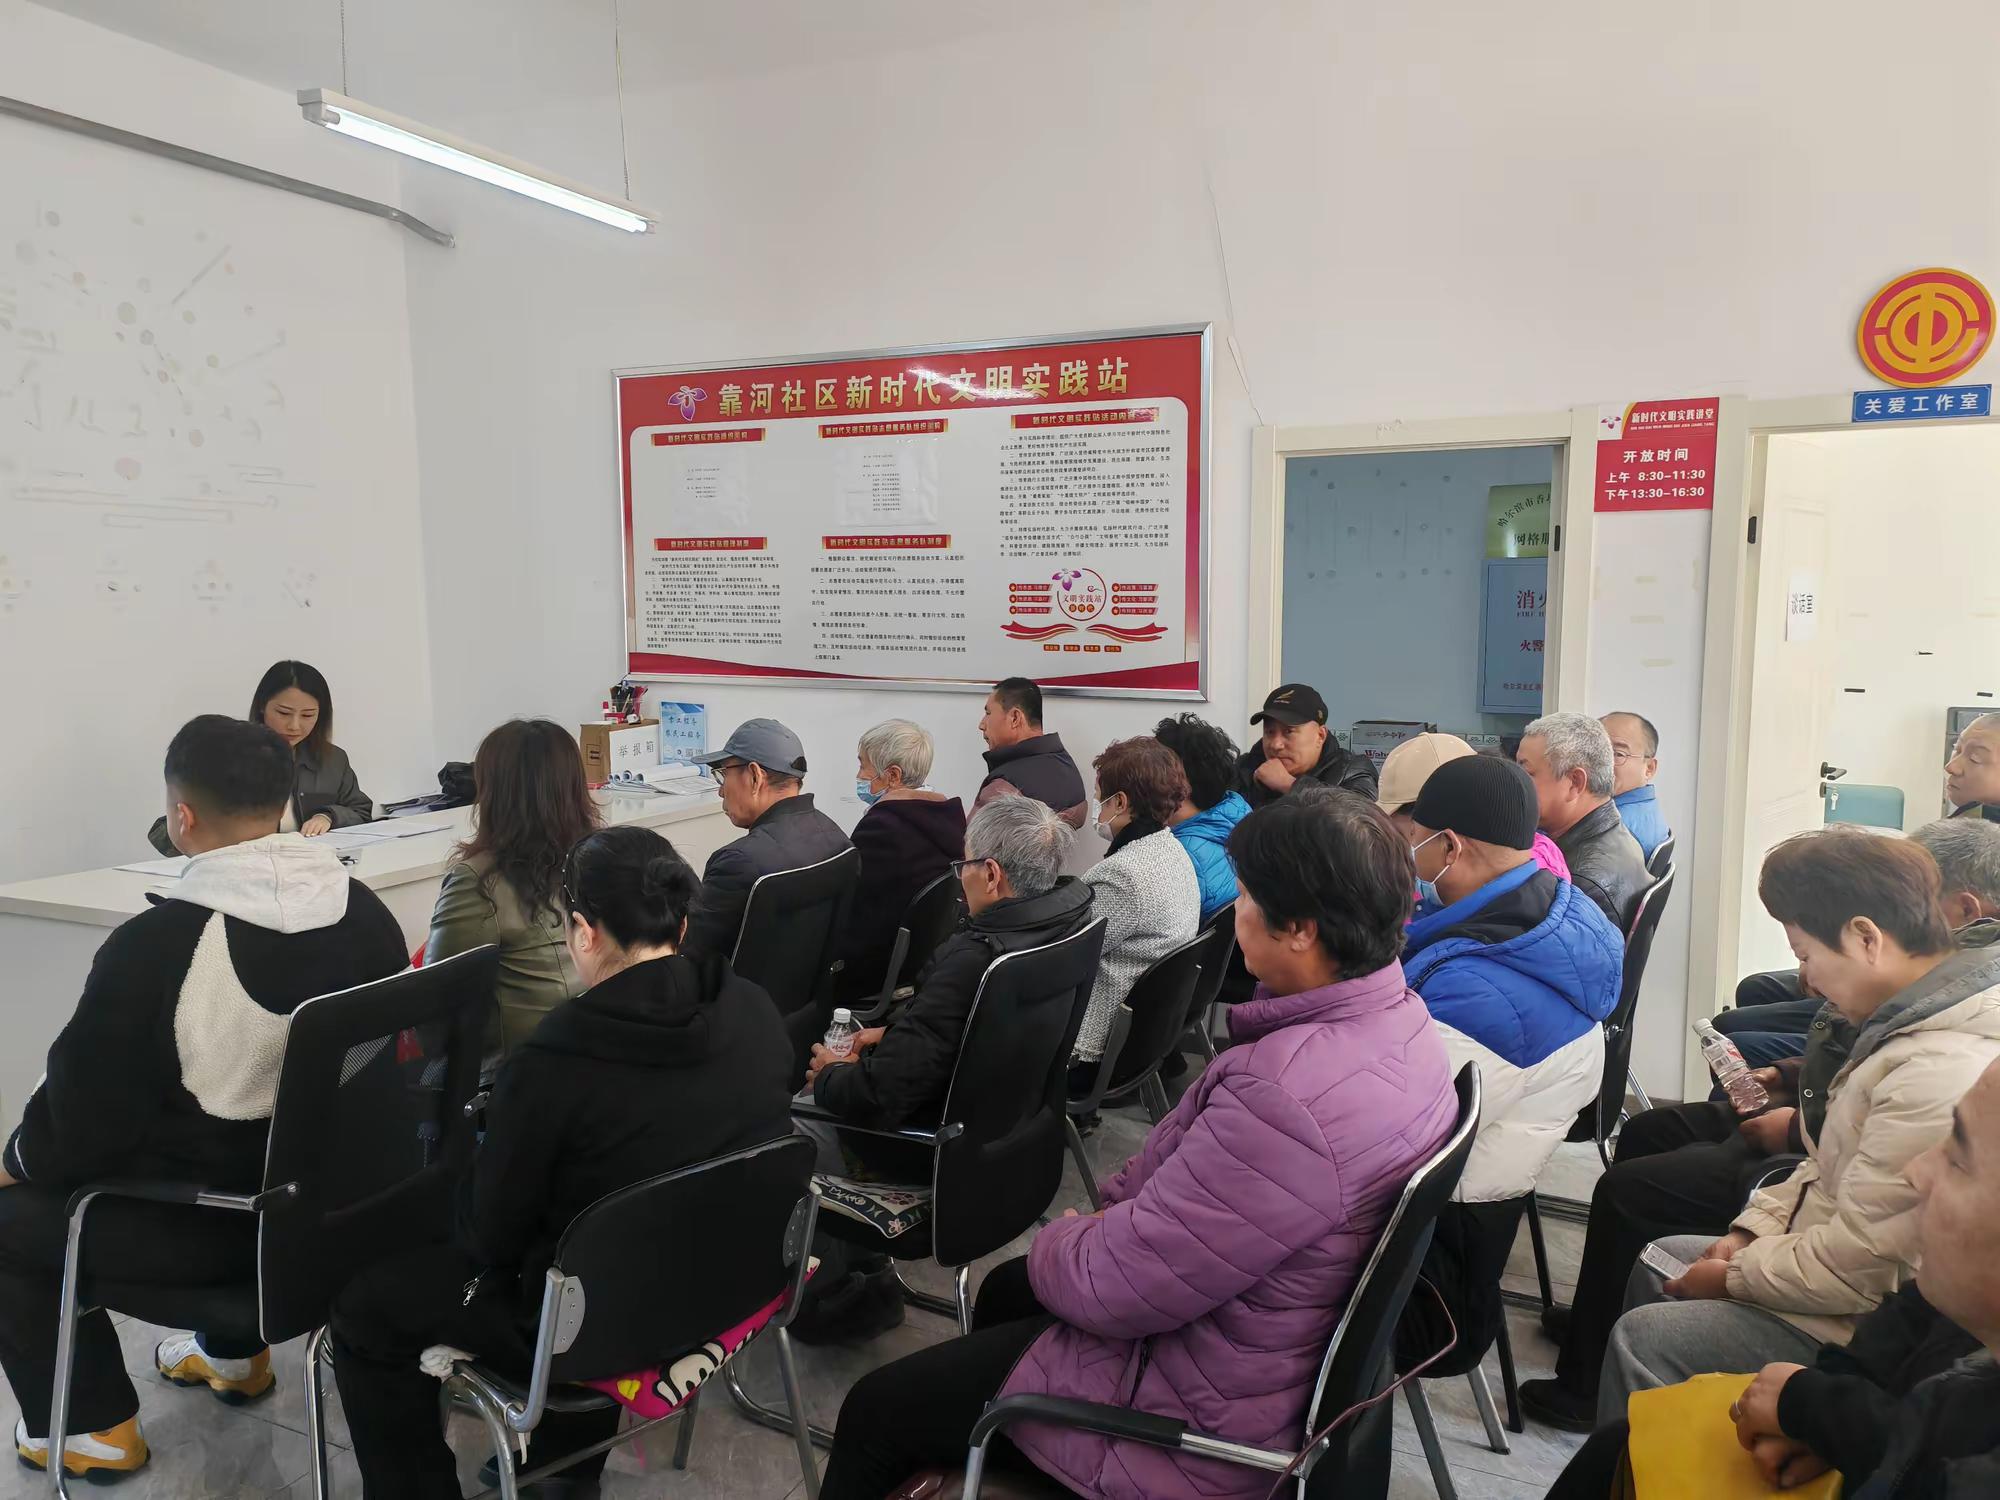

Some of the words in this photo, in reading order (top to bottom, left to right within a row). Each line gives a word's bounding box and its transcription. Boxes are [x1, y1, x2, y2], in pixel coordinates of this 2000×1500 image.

[718, 357, 1129, 416] 靠河社区新时代文明实践站
[1864, 393, 1978, 415] 关爱工作室
[1632, 408, 1714, 423] 新时代文明实践讲堂
[1623, 448, 1689, 463] 开放时间
[1605, 471, 1630, 483] 上午
[1638, 469, 1706, 481] 8:30-11:30
[1063, 594, 1103, 604] 文明实践站
